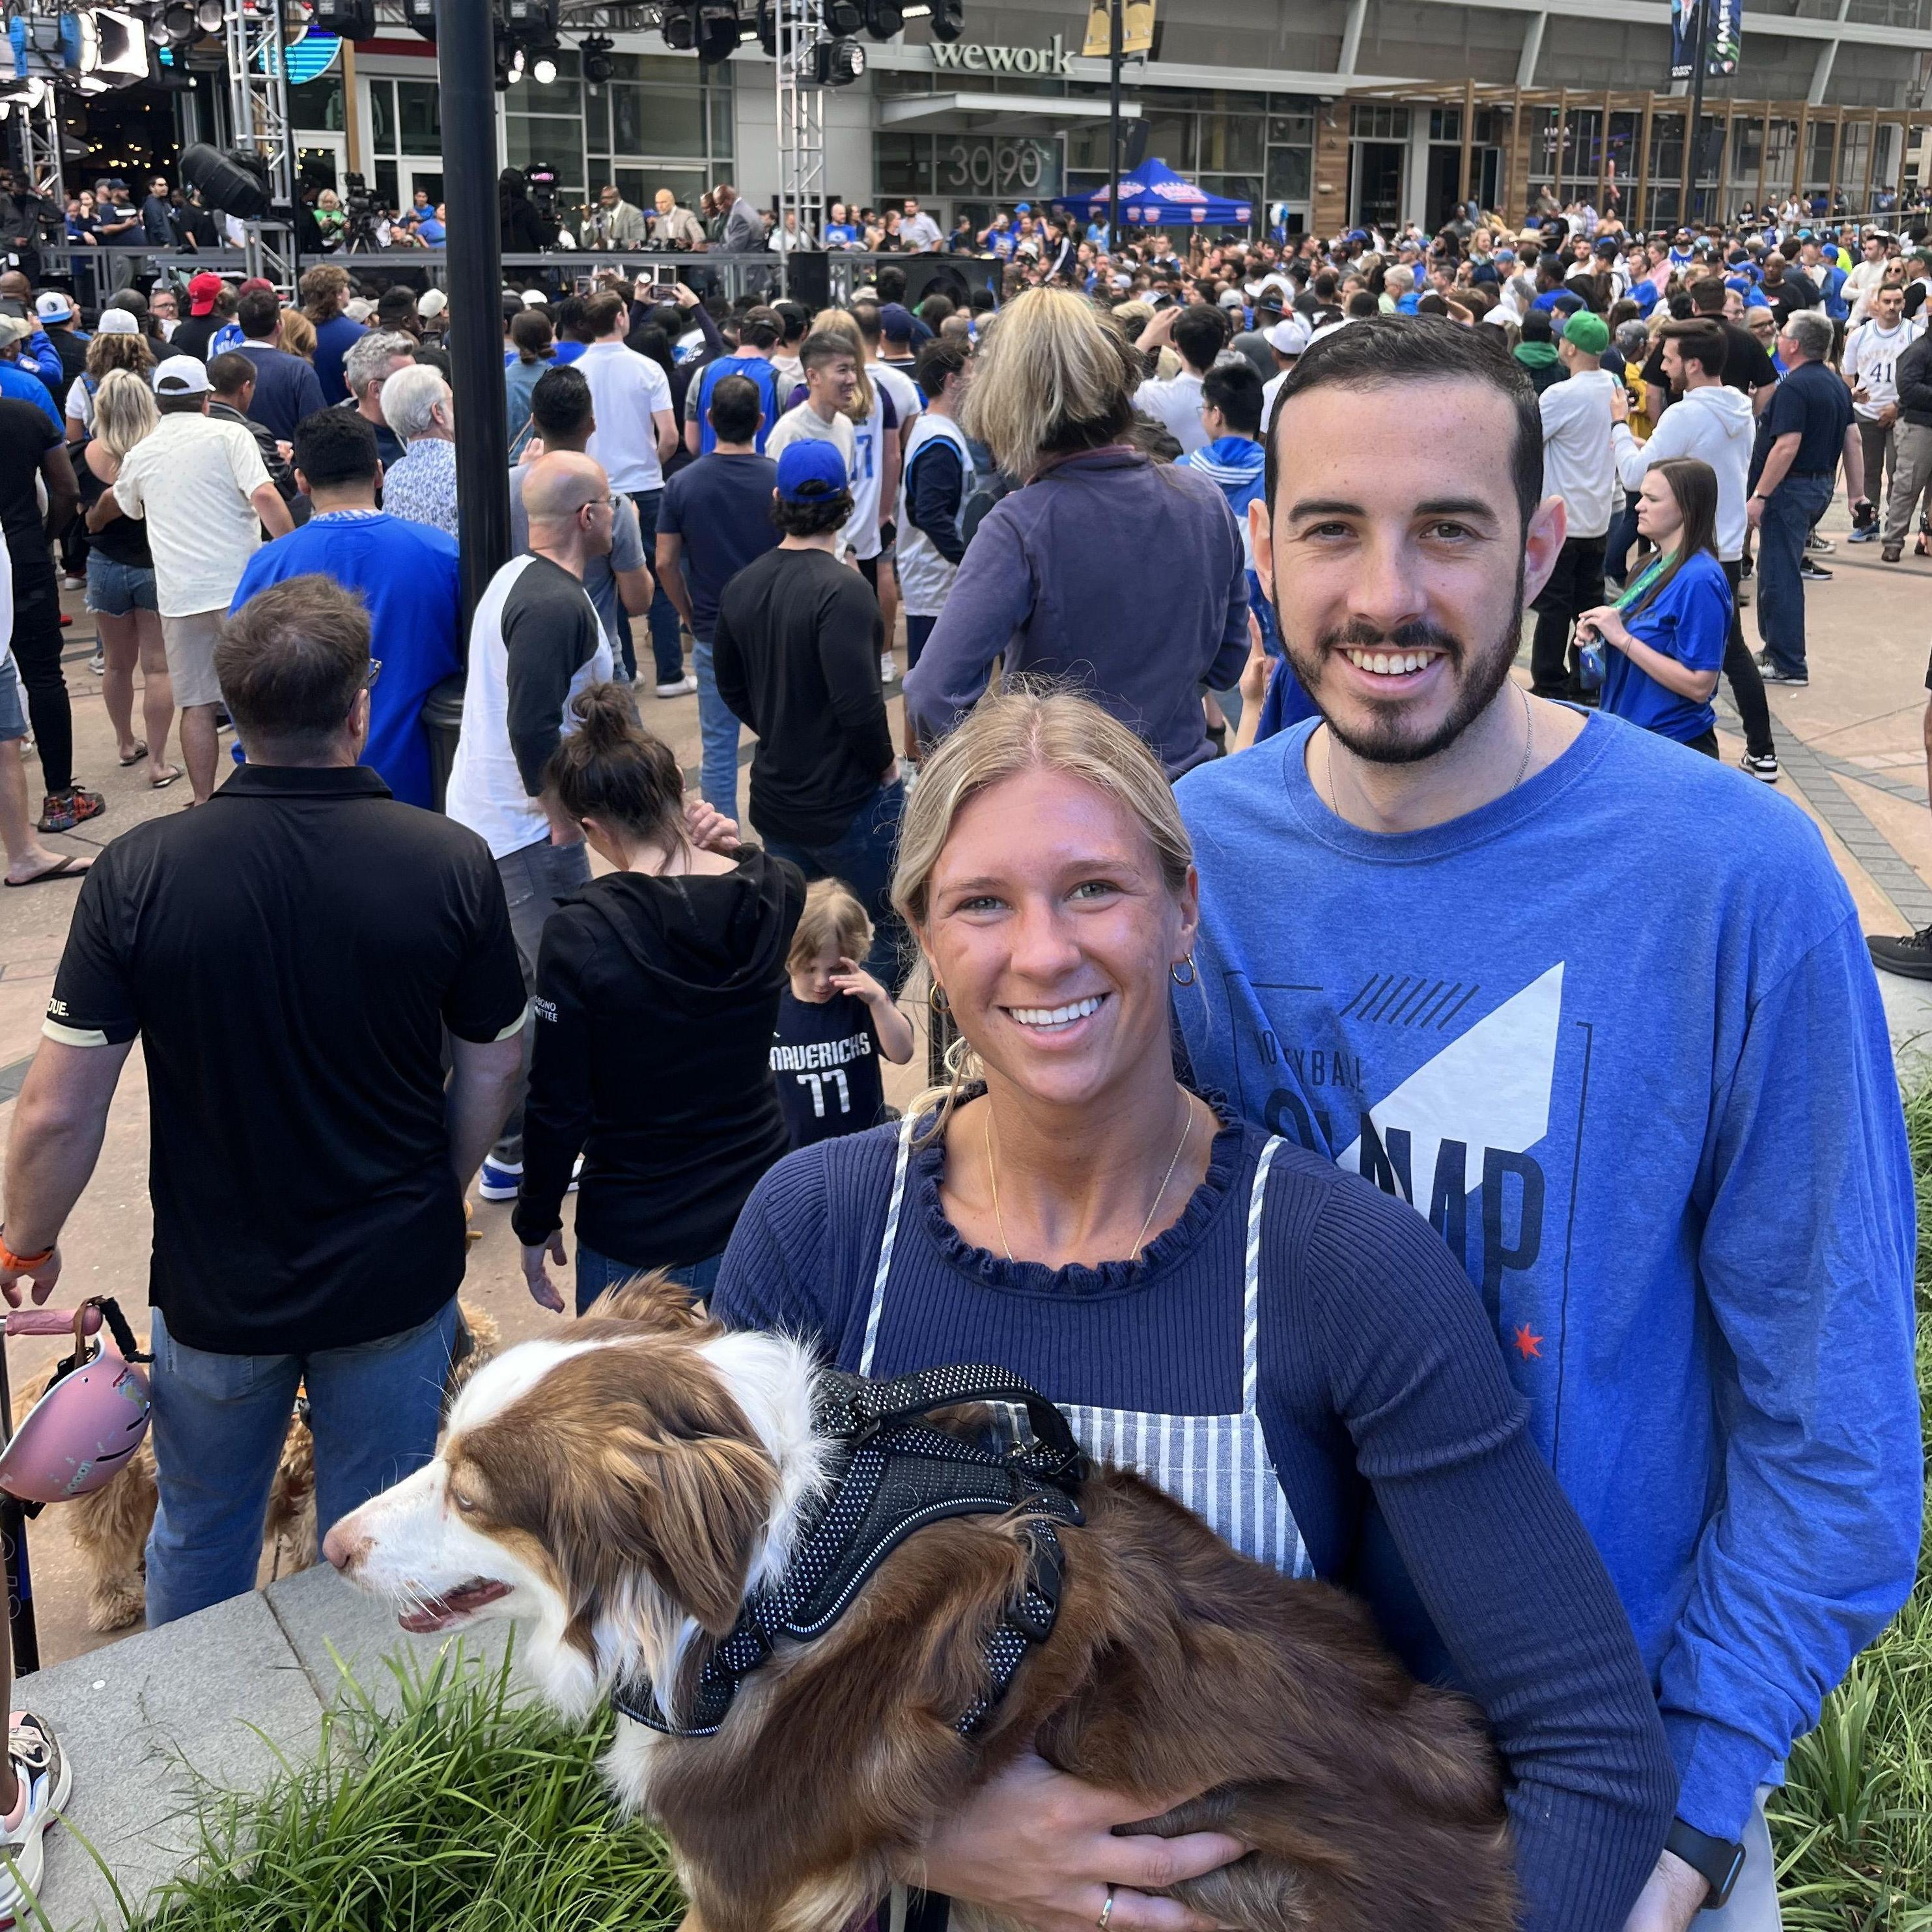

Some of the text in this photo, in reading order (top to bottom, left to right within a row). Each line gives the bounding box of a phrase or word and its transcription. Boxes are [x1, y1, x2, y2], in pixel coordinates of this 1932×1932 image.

[929, 34, 1076, 75] wework
[948, 145, 1042, 188] 3090
[1869, 362, 1892, 383] 41
[796, 1069, 851, 1118] 77
[1265, 1087, 1546, 1344] MP
